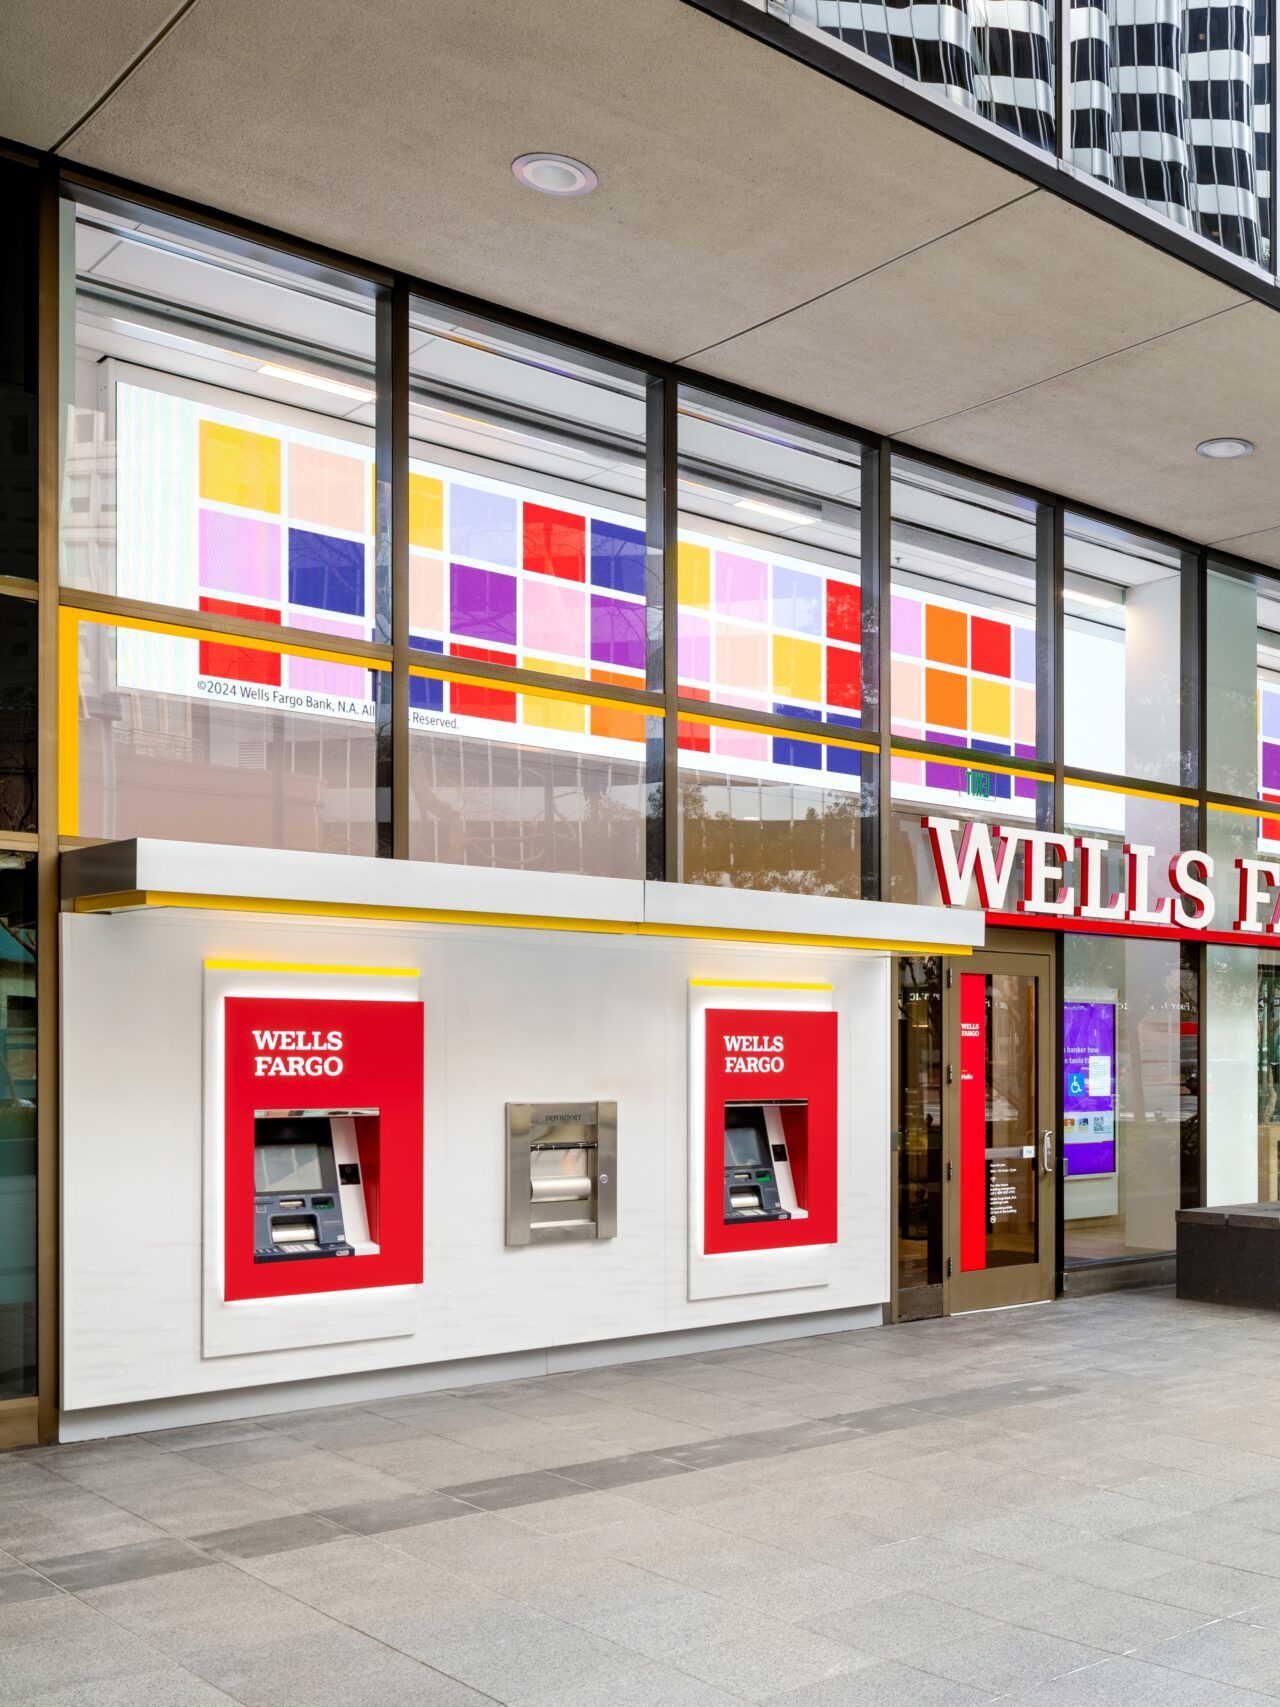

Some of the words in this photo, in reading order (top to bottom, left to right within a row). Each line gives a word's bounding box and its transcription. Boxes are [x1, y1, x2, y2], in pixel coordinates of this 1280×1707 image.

[197, 680, 236, 697] ©2024
[240, 686, 270, 702] Wells
[273, 690, 303, 708] Fargo
[306, 695, 335, 713] Bank,
[338, 700, 359, 715] N.A.
[362, 704, 375, 717] All
[412, 711, 459, 730] Reserved.
[921, 816, 1214, 930] WELLS
[252, 1030, 343, 1051] WELLS
[723, 1035, 784, 1052] WELLS
[1066, 1046, 1086, 1054] banker
[1087, 1046, 1100, 1054] how
[254, 1056, 344, 1076] FARGO
[724, 1056, 785, 1073] FARGO
